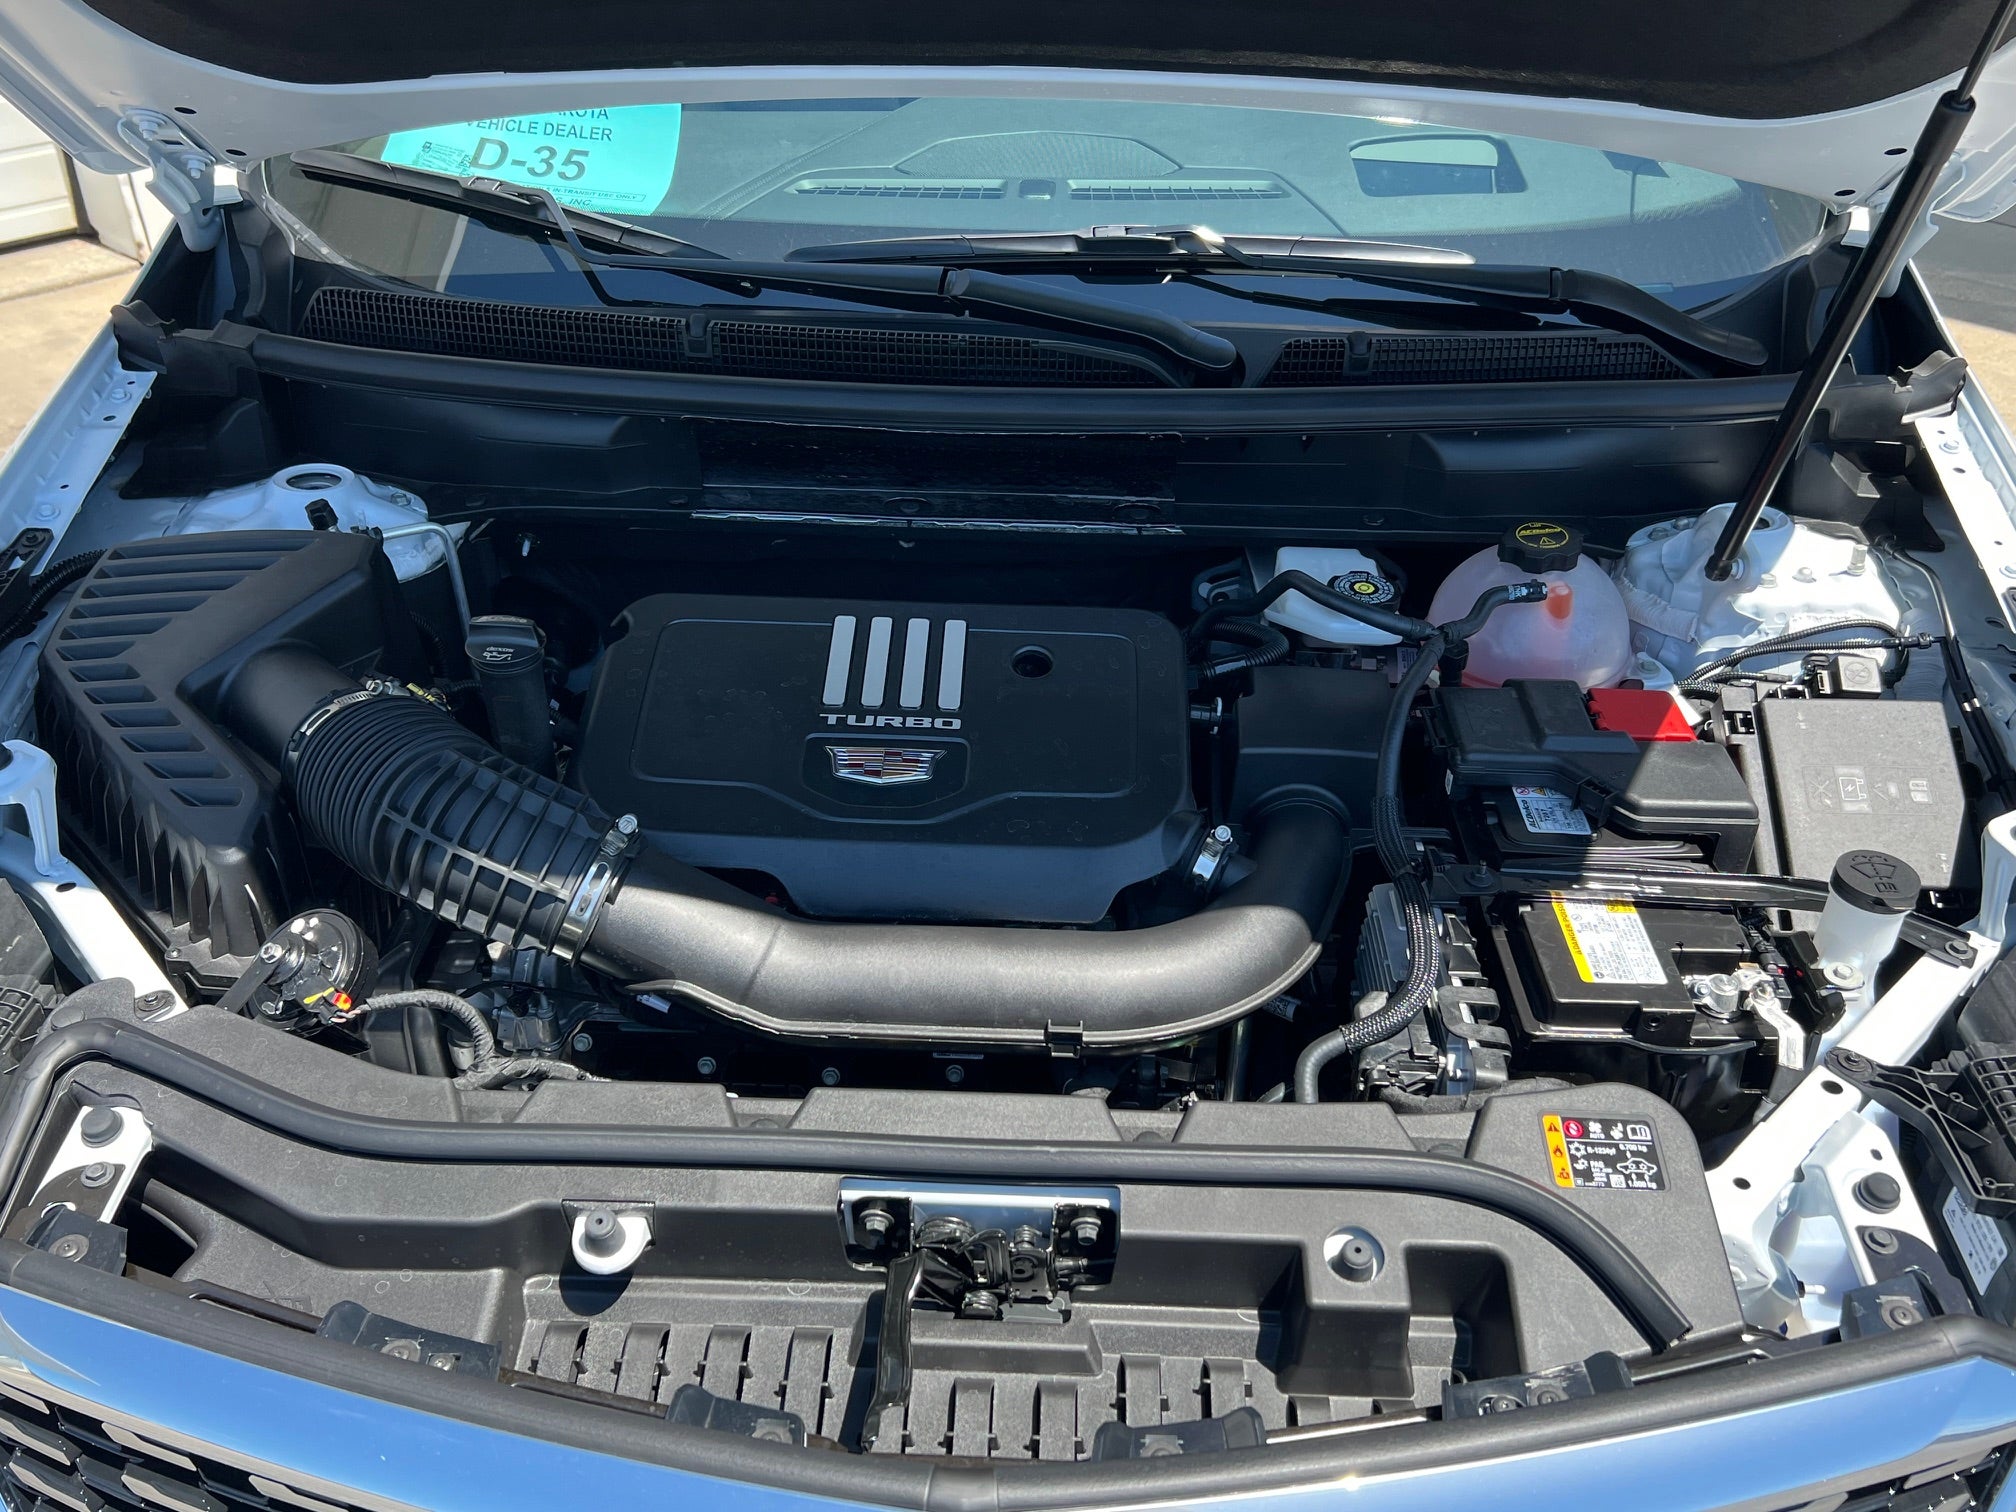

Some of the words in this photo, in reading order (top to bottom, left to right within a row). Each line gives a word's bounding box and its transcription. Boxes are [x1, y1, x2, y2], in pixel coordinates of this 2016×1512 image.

[543, 122, 613, 142] DEALER
[470, 137, 590, 181] D-35
[819, 713, 962, 730] TURBO
[1557, 901, 1569, 922] POISO
[1637, 1144, 1648, 1153] kg
[1647, 1181, 1657, 1190] kg
